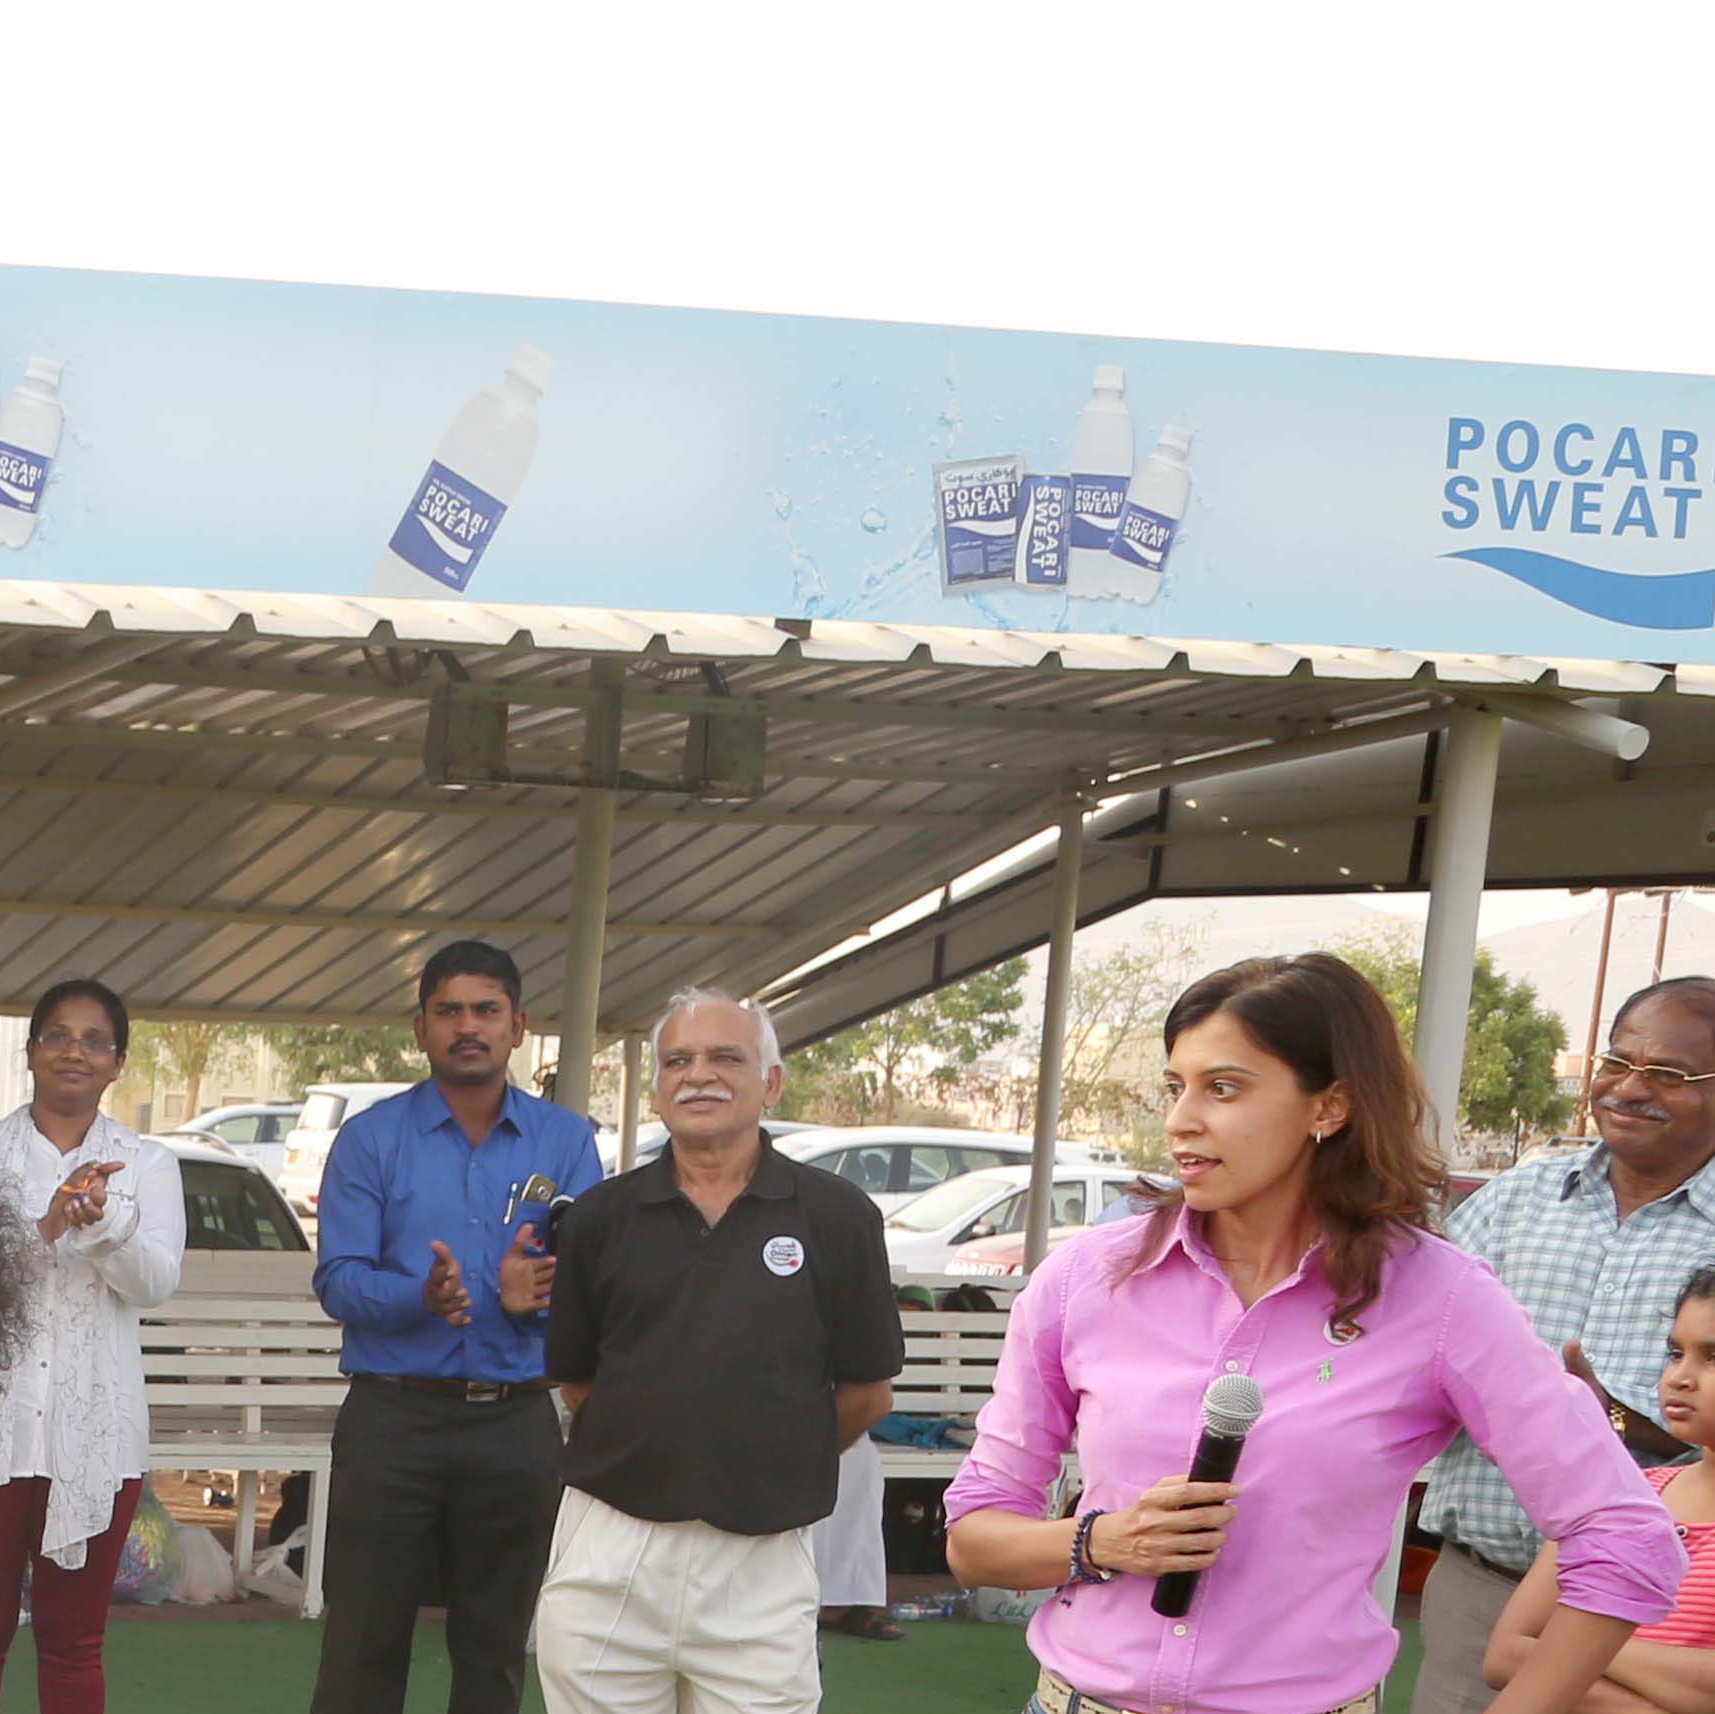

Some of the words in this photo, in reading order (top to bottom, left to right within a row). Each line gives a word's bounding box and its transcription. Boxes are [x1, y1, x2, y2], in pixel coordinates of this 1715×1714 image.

[1445, 418, 1715, 482] POCAR
[426, 485, 489, 533] POCARI
[945, 484, 1016, 505] POCARI
[946, 498, 1011, 520] SWEAT
[1075, 490, 1123, 503] POCARI
[1075, 501, 1119, 513] SWEAT
[1442, 475, 1703, 539] SWEAT
[419, 498, 479, 541] SWEAT
[1031, 485, 1049, 568] SWEAT
[1044, 487, 1062, 576] POCARI
[1126, 516, 1170, 539] POCARI
[1122, 526, 1164, 548] SWEAT
